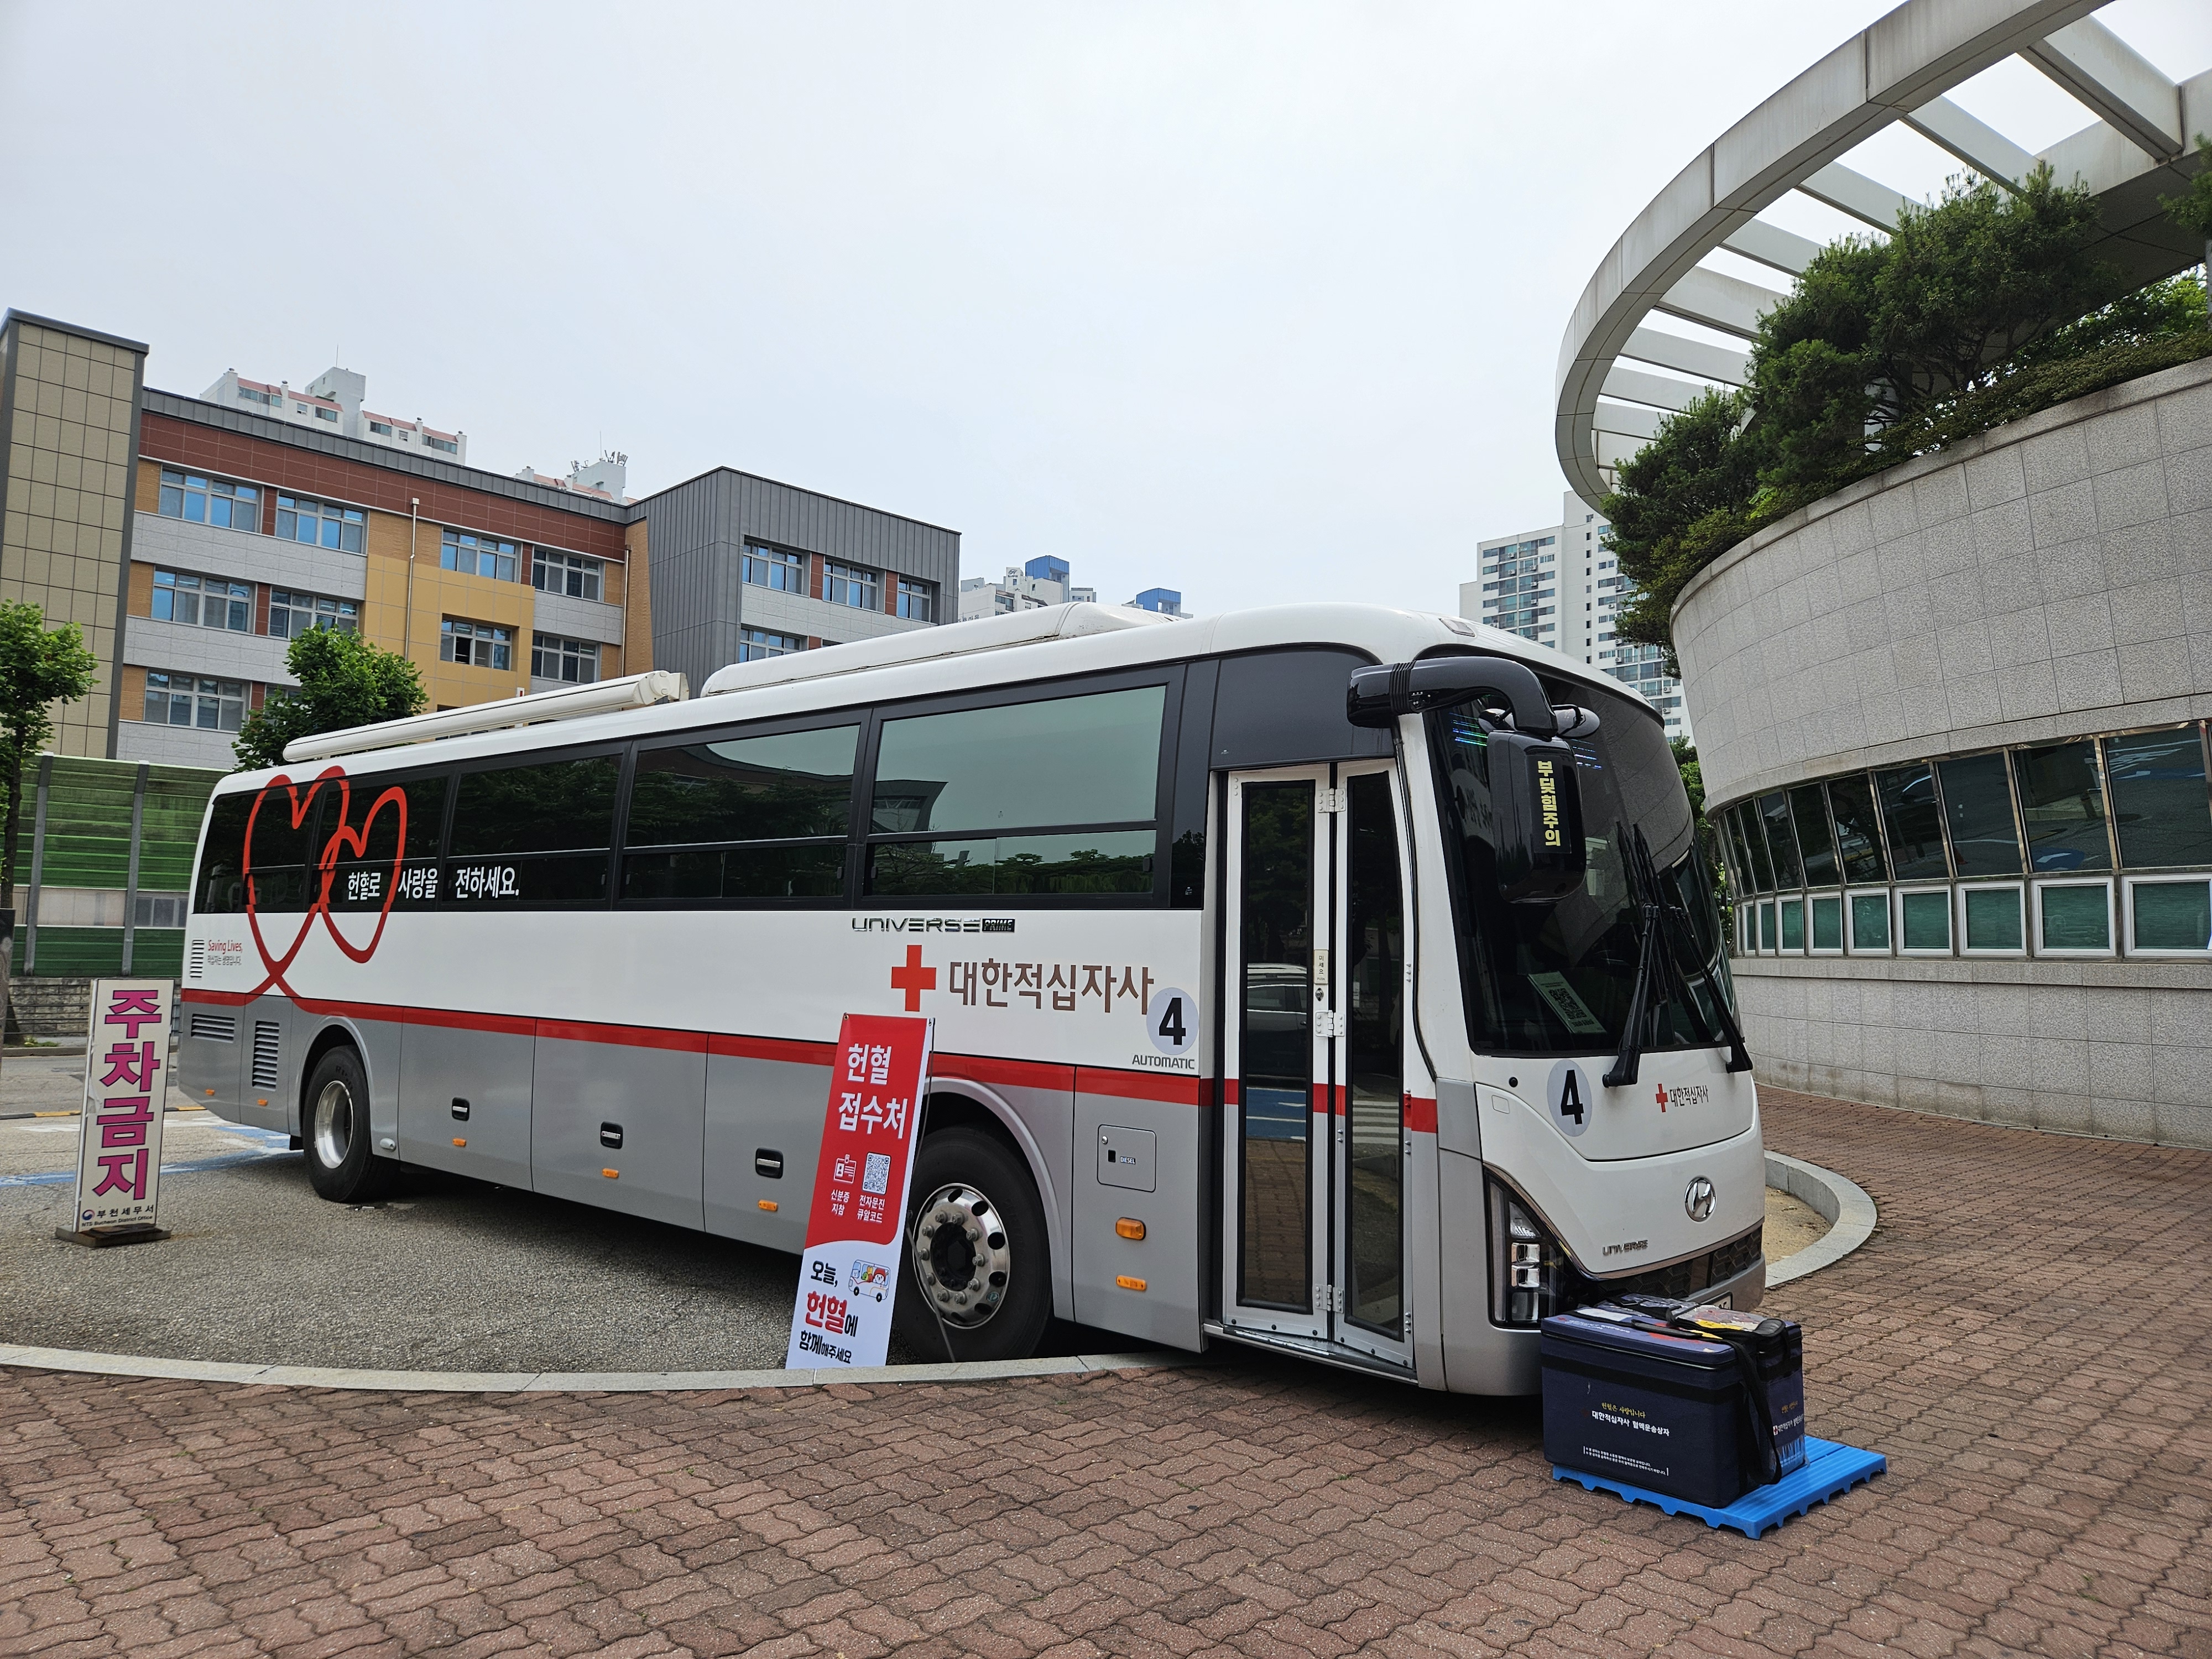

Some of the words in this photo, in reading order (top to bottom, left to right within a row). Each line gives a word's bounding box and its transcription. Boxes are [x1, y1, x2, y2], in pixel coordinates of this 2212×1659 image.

[1537, 760, 1561, 847] 부딪힘주의
[347, 871, 382, 901] 헌혈로
[397, 867, 439, 899] 사랑을
[455, 865, 520, 899] 전하세요.
[851, 917, 981, 933] UNIVERSE
[983, 919, 1015, 932] PRIME
[207, 939, 227, 955] Saving
[949, 957, 1155, 1015] 대한적십자사
[1159, 997, 1186, 1046] 4
[847, 1043, 892, 1085] 헌혈
[1131, 1054, 1195, 1070] AUTOMATIC
[92, 989, 163, 1200] 주차금지
[1560, 1069, 1584, 1125] 4
[1669, 1084, 1709, 1108] 대한적십자사
[838, 1092, 908, 1139] 접수처
[831, 1189, 850, 1203] 신분증
[859, 1194, 885, 1211] 전자문진
[97, 1204, 154, 1219] 부천세무서
[831, 1203, 846, 1216] 지참
[857, 1208, 883, 1223] 큐알코드
[810, 1260, 838, 1288] 오늘,
[805, 1291, 859, 1338] 헌혈에
[799, 1329, 852, 1364] 함께해주세요
[1592, 1410, 1630, 1427] 대한적십자사
[1619, 1406, 1646, 1419] 사랑입니다
